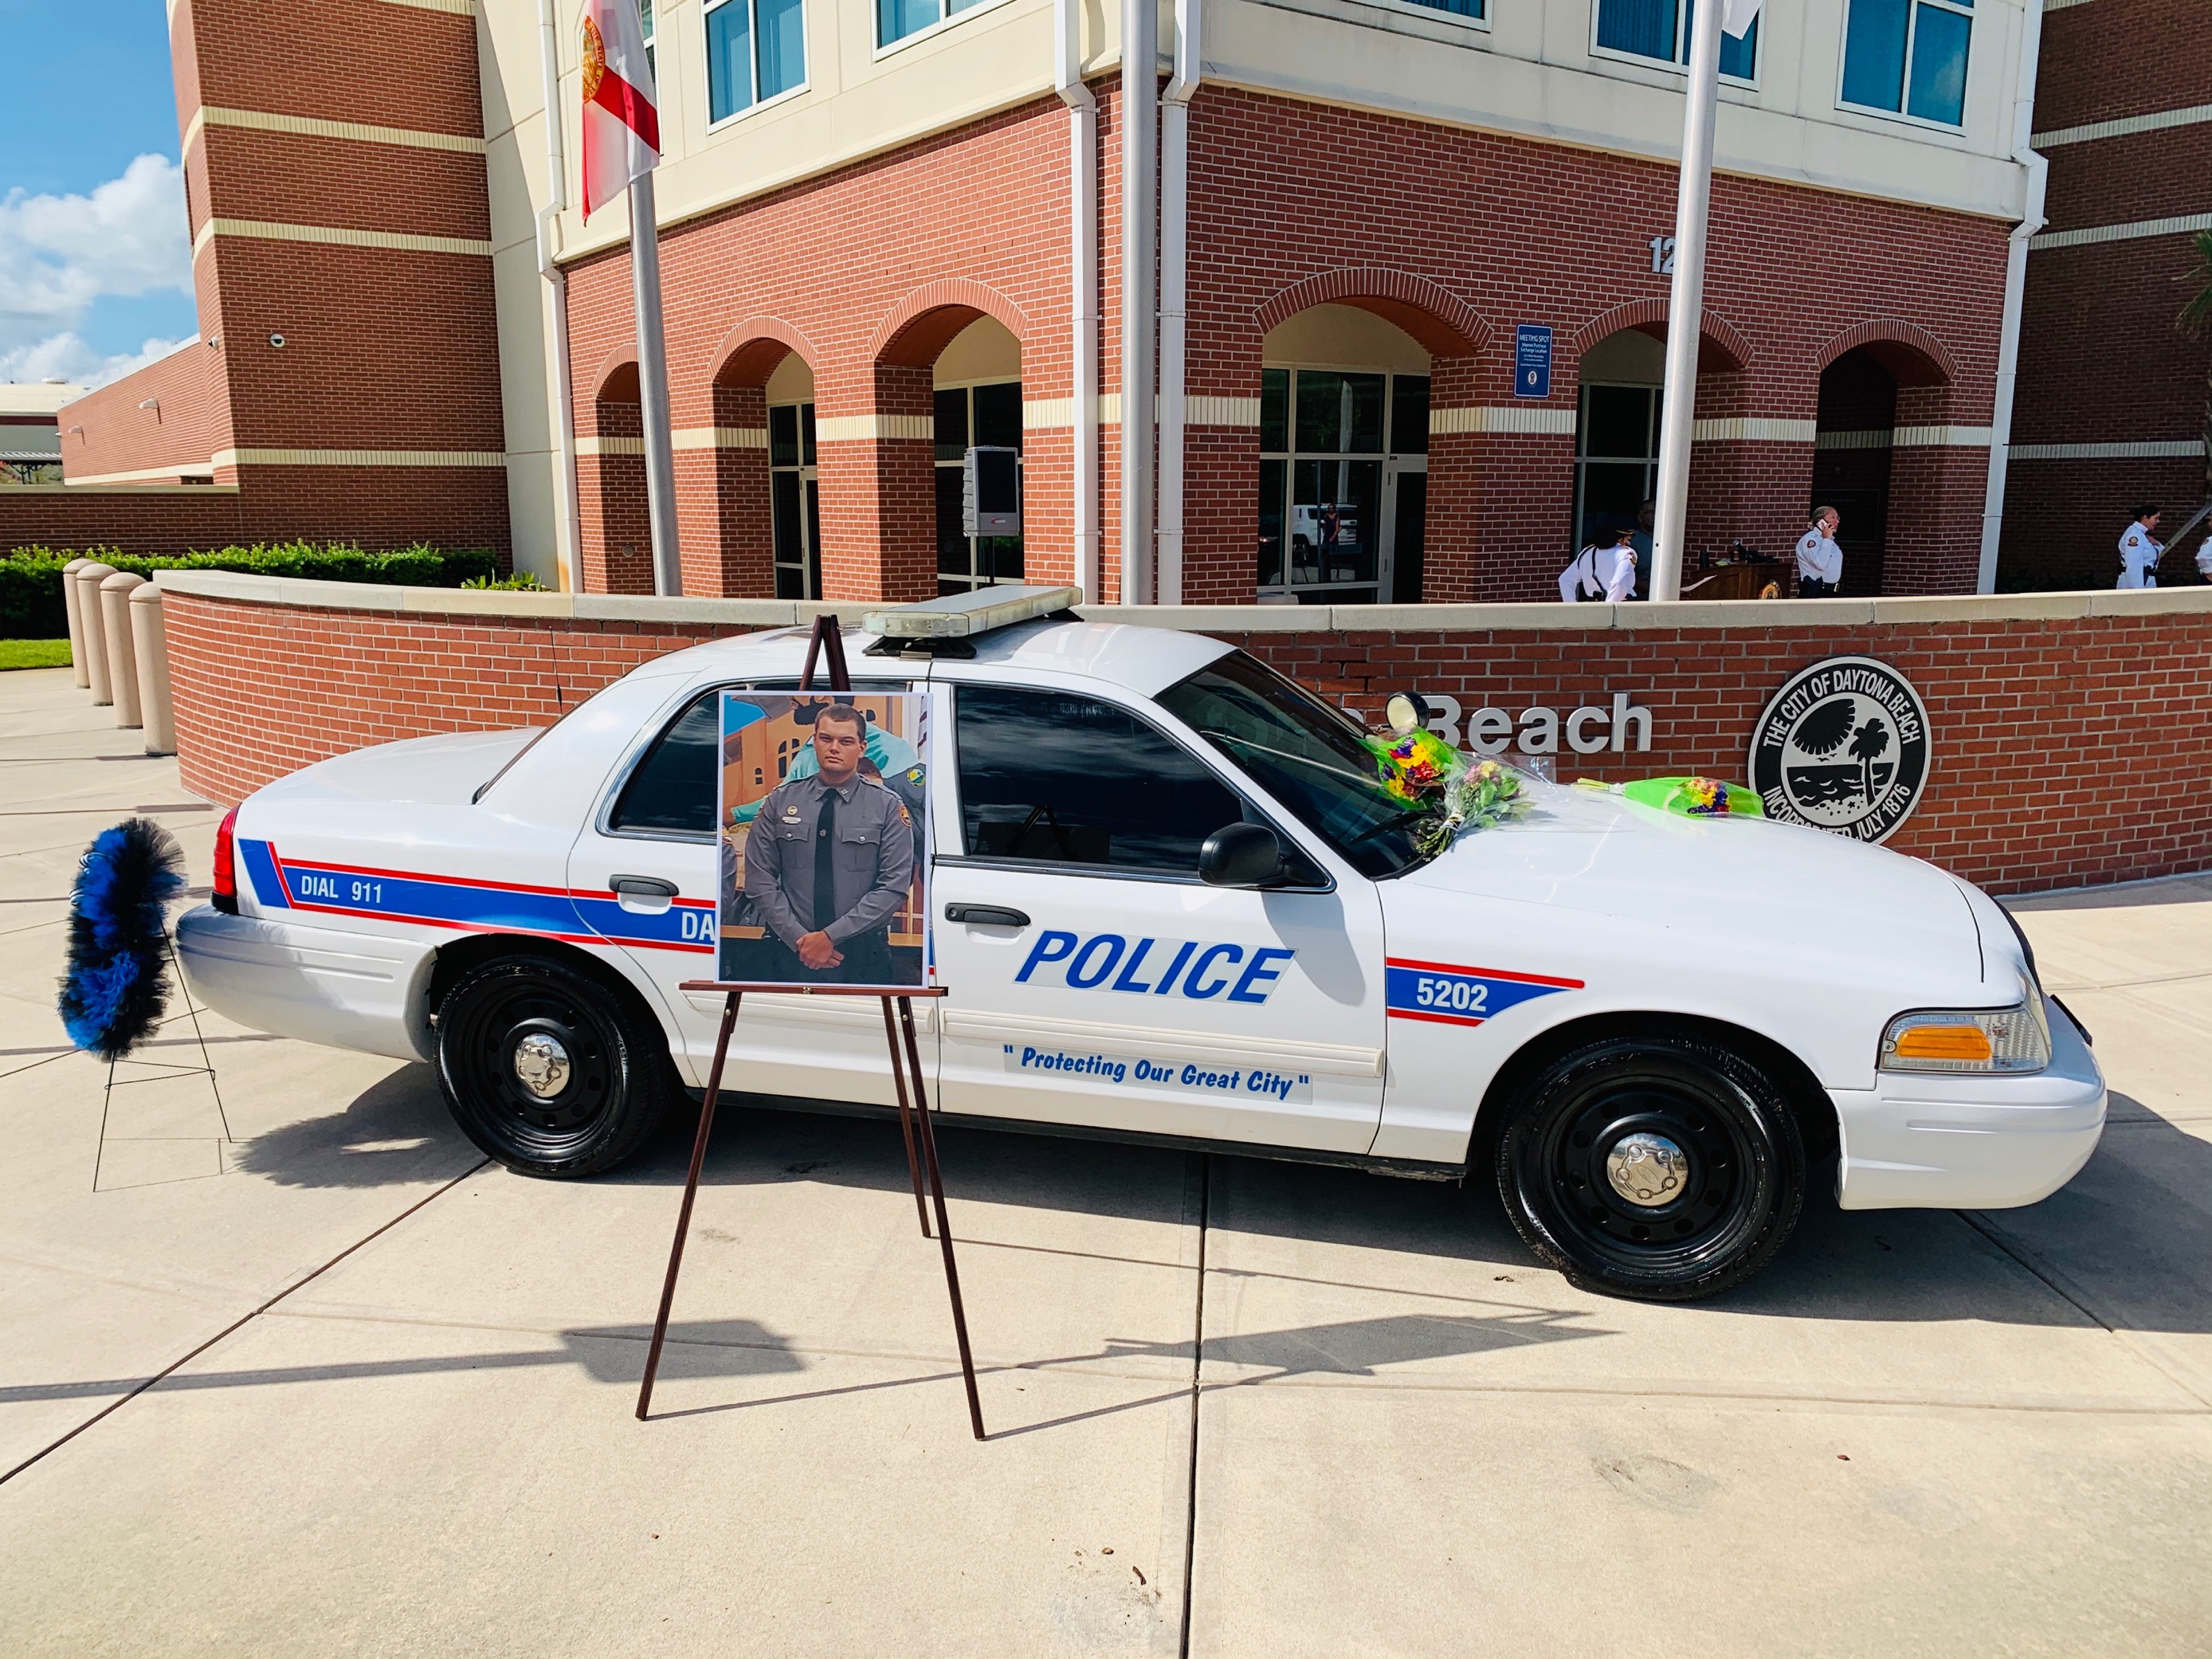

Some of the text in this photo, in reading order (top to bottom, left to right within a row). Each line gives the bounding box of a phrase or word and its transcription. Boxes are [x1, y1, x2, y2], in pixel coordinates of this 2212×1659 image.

[1421, 692, 1653, 755] Beach
[1763, 669, 1921, 747] THE CITY OF DAYTONA BEACH
[1855, 811, 1886, 841] JULY
[1881, 783, 1912, 818] 1876
[301, 875, 382, 904] DIAL 911
[1015, 930, 1296, 1004] POLICE
[1416, 977, 1488, 1013] 5202
[1021, 1046, 1127, 1083] Protecting
[1134, 1059, 1175, 1083] Our
[1180, 1064, 1241, 1090] Great
[1247, 1070, 1293, 1101] City
